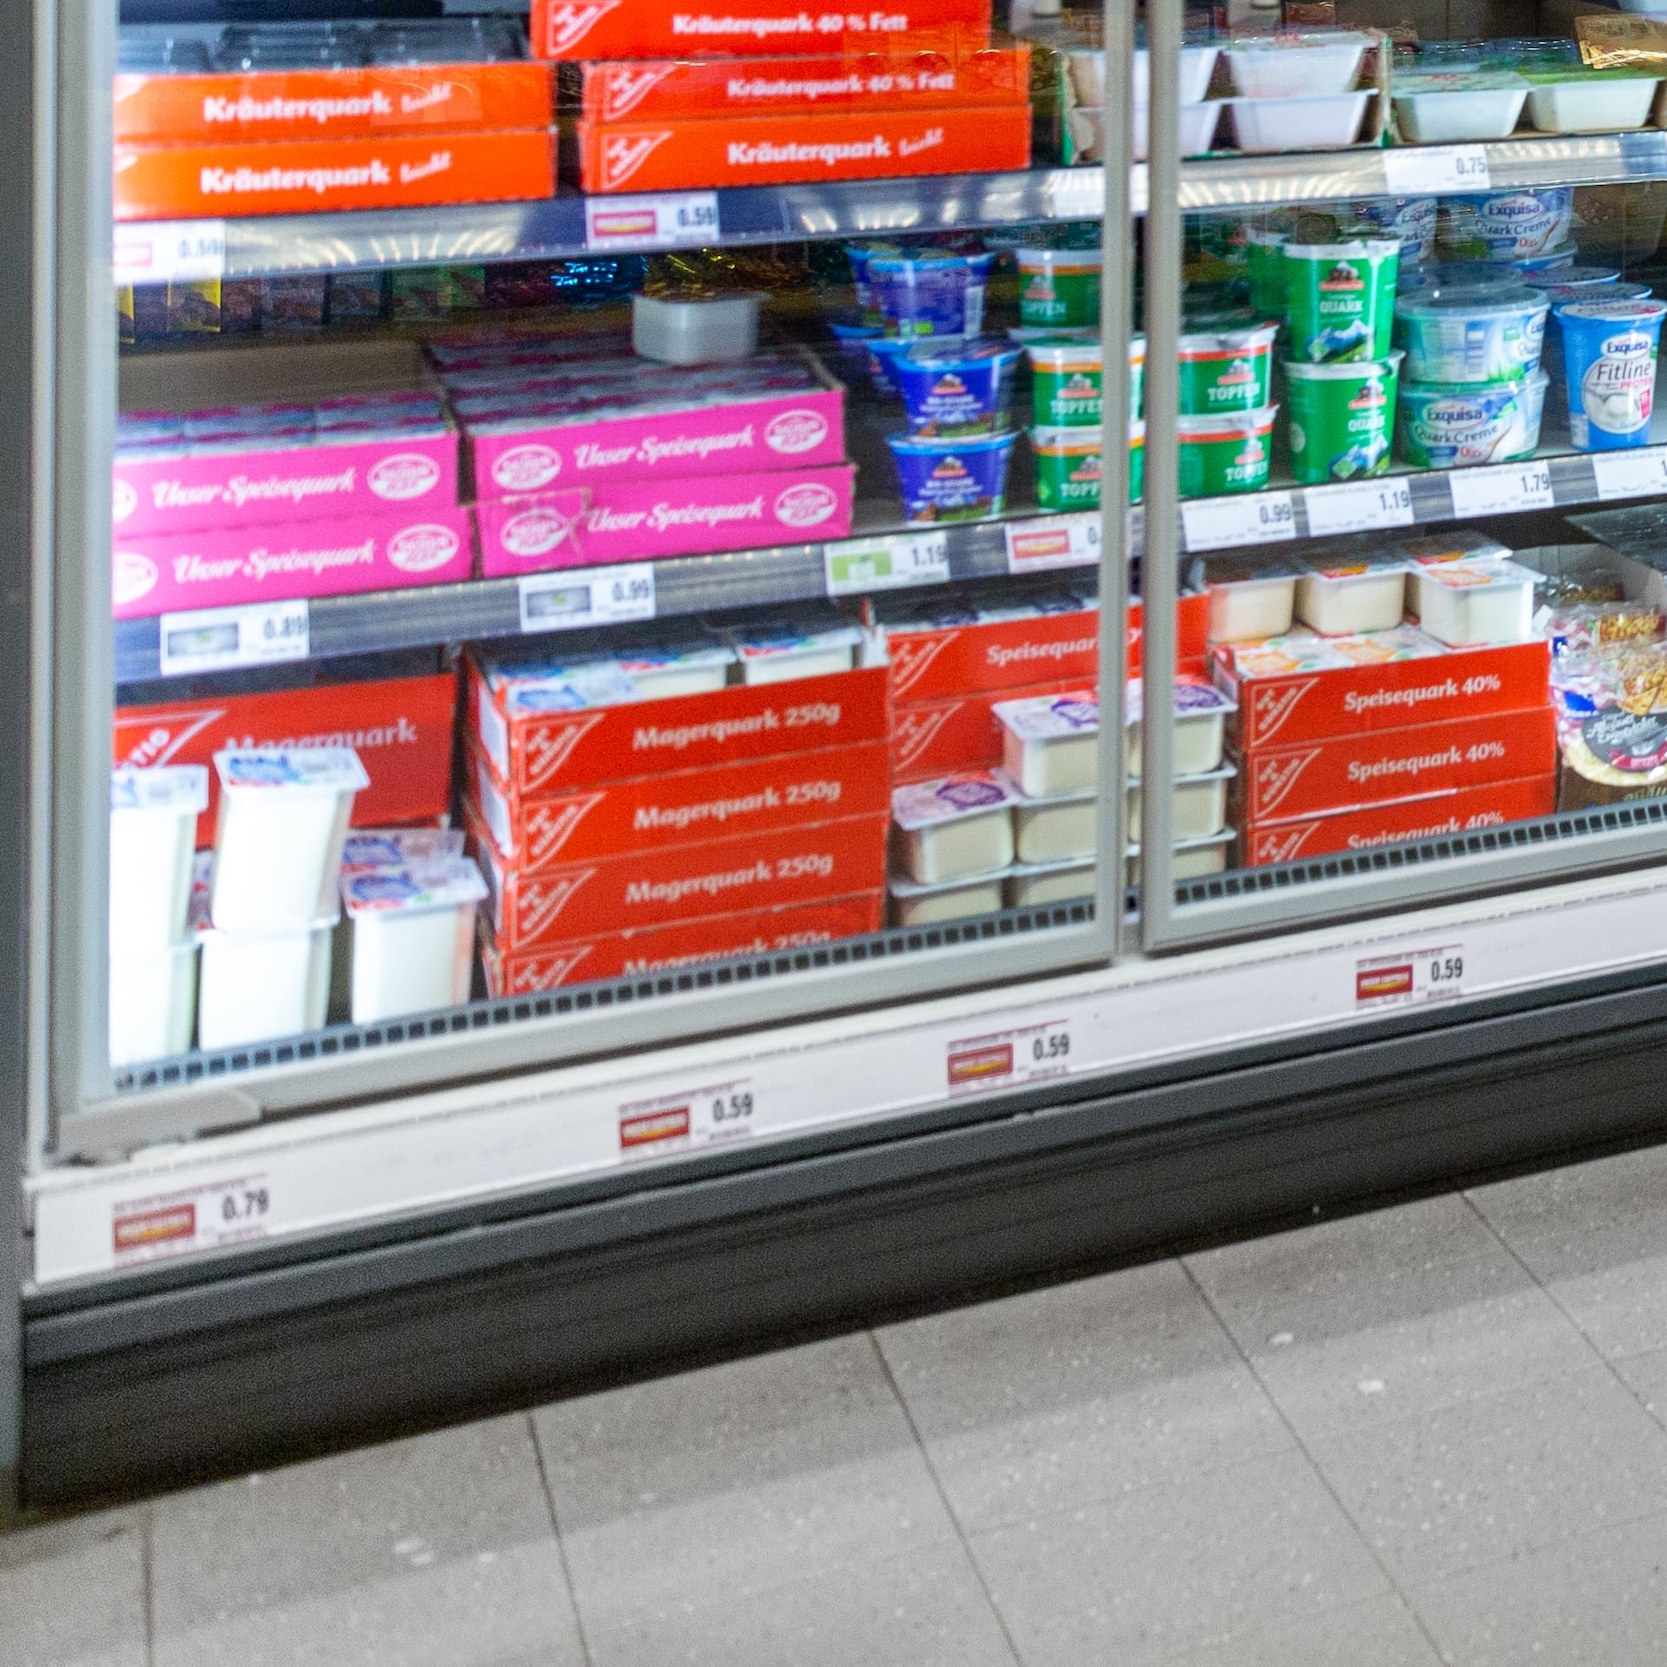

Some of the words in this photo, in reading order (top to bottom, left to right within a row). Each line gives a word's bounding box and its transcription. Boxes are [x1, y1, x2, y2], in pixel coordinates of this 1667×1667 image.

[673, 15, 812, 37] Kräuterquark
[816, 14, 845, 32] 40
[847, 14, 863, 32] %
[868, 13, 908, 32] Fett
[728, 76, 863, 100] Kräuterquark
[866, 76, 892, 92] 40
[895, 75, 914, 91] %
[918, 73, 955, 91] Fett
[204, 90, 391, 122] Kräuterquark
[728, 135, 892, 166] Kräuterquark
[201, 159, 391, 194] Kräuterquark
[1487, 200, 1544, 217] Exquisa
[1319, 300, 1363, 314] QUARK
[1606, 338, 1649, 356] Exquisa
[1596, 360, 1651, 383] Fitline
[1207, 382, 1260, 402] TOPFEN
[642, 423, 753, 466] Speisequark
[1521, 474, 1550, 492] 1.79
[1260, 504, 1291, 523] 0.99
[240, 539, 376, 577] Speisequark
[1344, 676, 1456, 716] Speisequark
[1459, 674, 1501, 695] 40%
[633, 707, 778, 748] Magerquark
[784, 702, 841, 728] 250g
[1348, 743, 1463, 784] Speisequark
[1466, 741, 1506, 762] 40%
[634, 784, 778, 828] Magerquark
[784, 779, 841, 805] 250g
[625, 857, 772, 904] Magerquark
[776, 853, 833, 882] 250g
[1033, 1034, 1070, 1062] 0.59
[223, 1188, 270, 1221] 0.79
